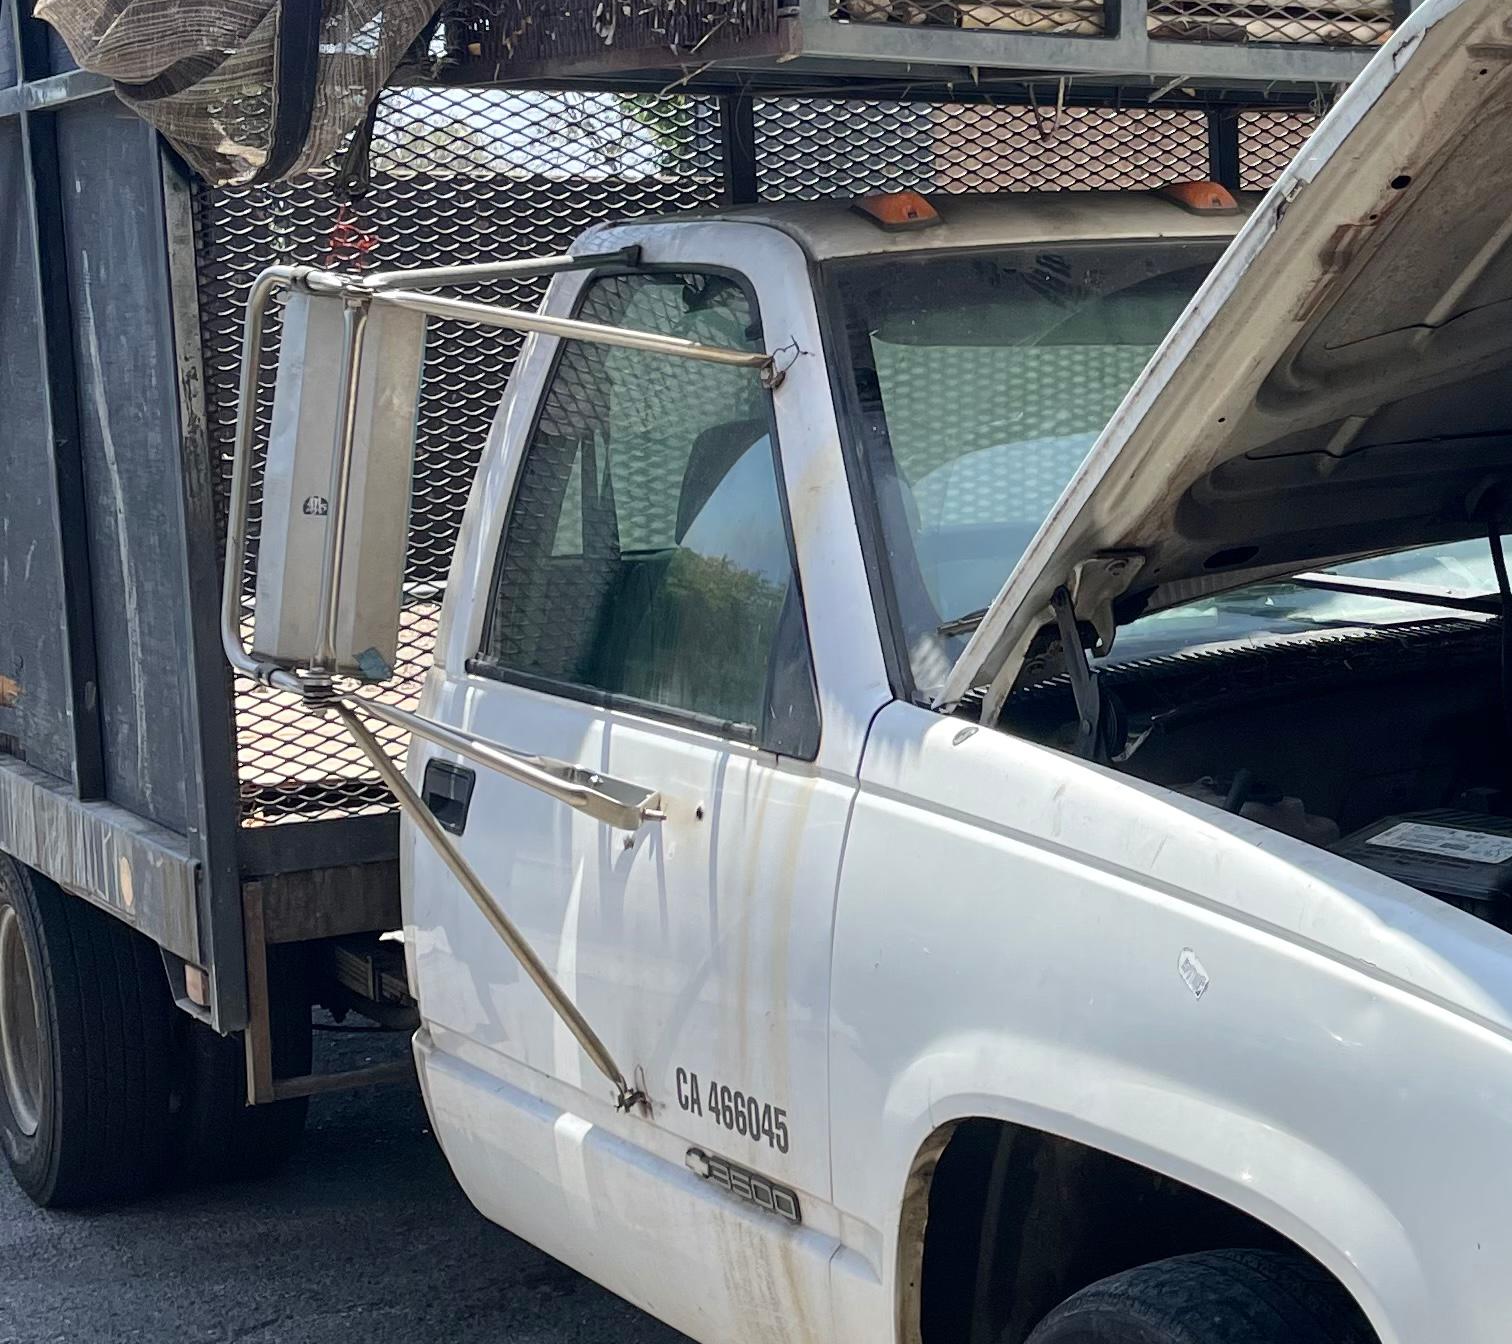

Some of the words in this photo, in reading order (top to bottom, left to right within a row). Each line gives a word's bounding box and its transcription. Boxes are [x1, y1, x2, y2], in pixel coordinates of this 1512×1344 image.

[676, 1066, 703, 1117] CA
[708, 1080, 790, 1155] 466045
[706, 1155, 800, 1224] 3500
